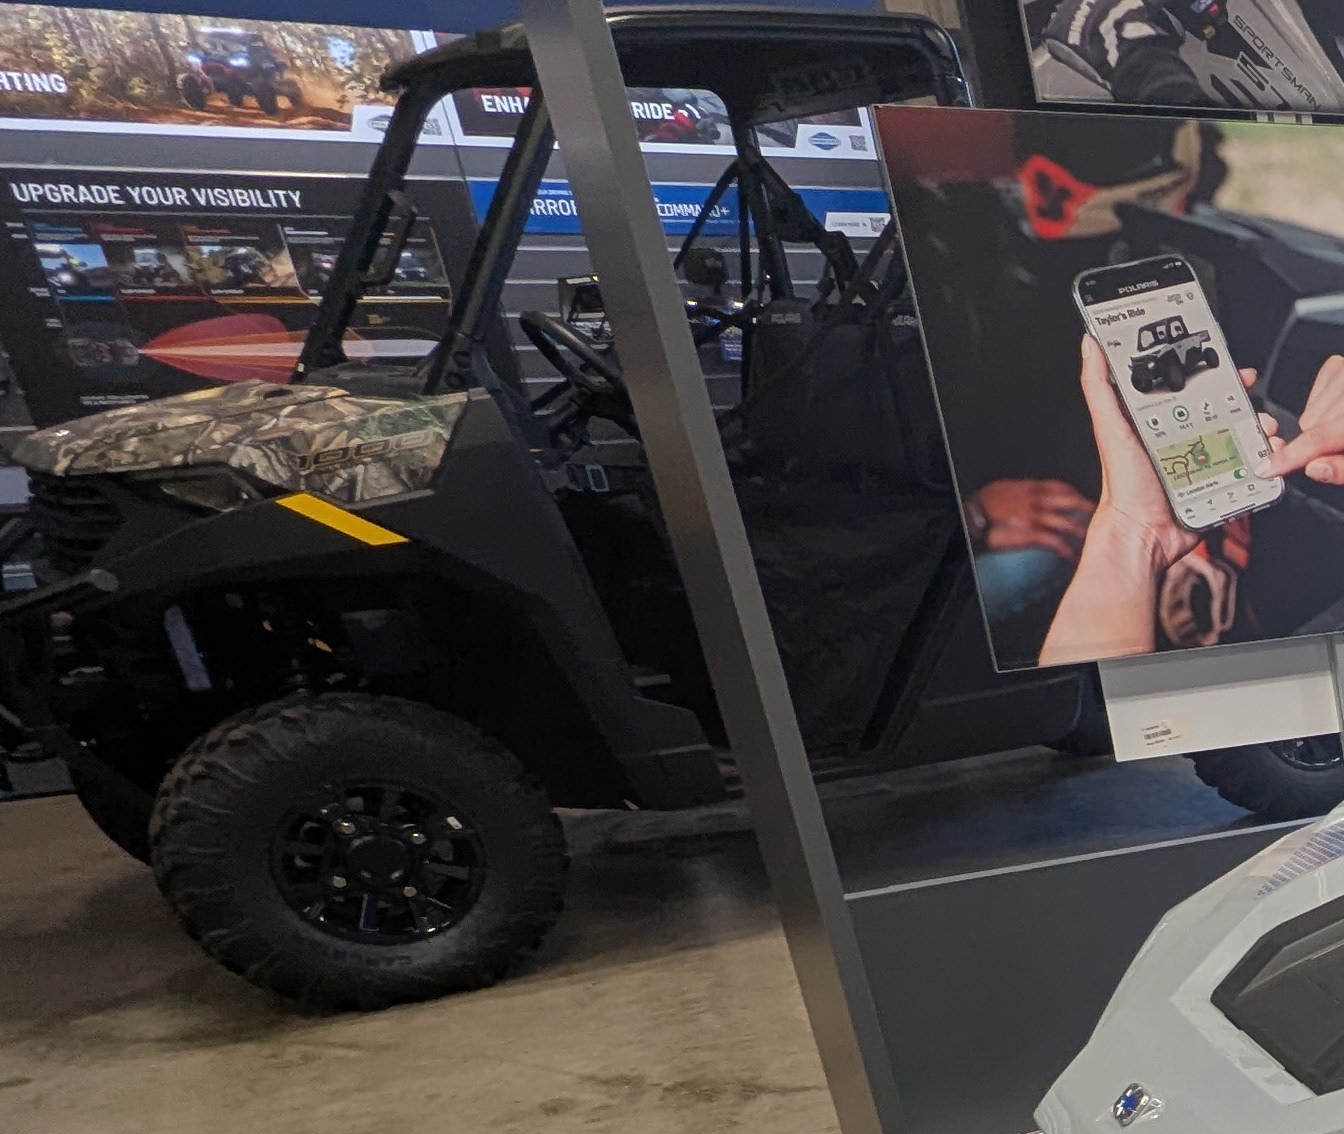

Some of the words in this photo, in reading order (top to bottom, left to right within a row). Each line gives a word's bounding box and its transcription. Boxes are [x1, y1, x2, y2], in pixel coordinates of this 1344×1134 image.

[481, 94, 530, 113] ENH
[631, 102, 674, 120] RIDE
[10, 182, 125, 204] UPGRADE
[126, 185, 188, 206] YOUR
[190, 187, 301, 208] VISIBILITY
[531, 199, 577, 216] RRO
[1118, 280, 1159, 295] POLARIS
[1128, 307, 1146, 318] Ride
